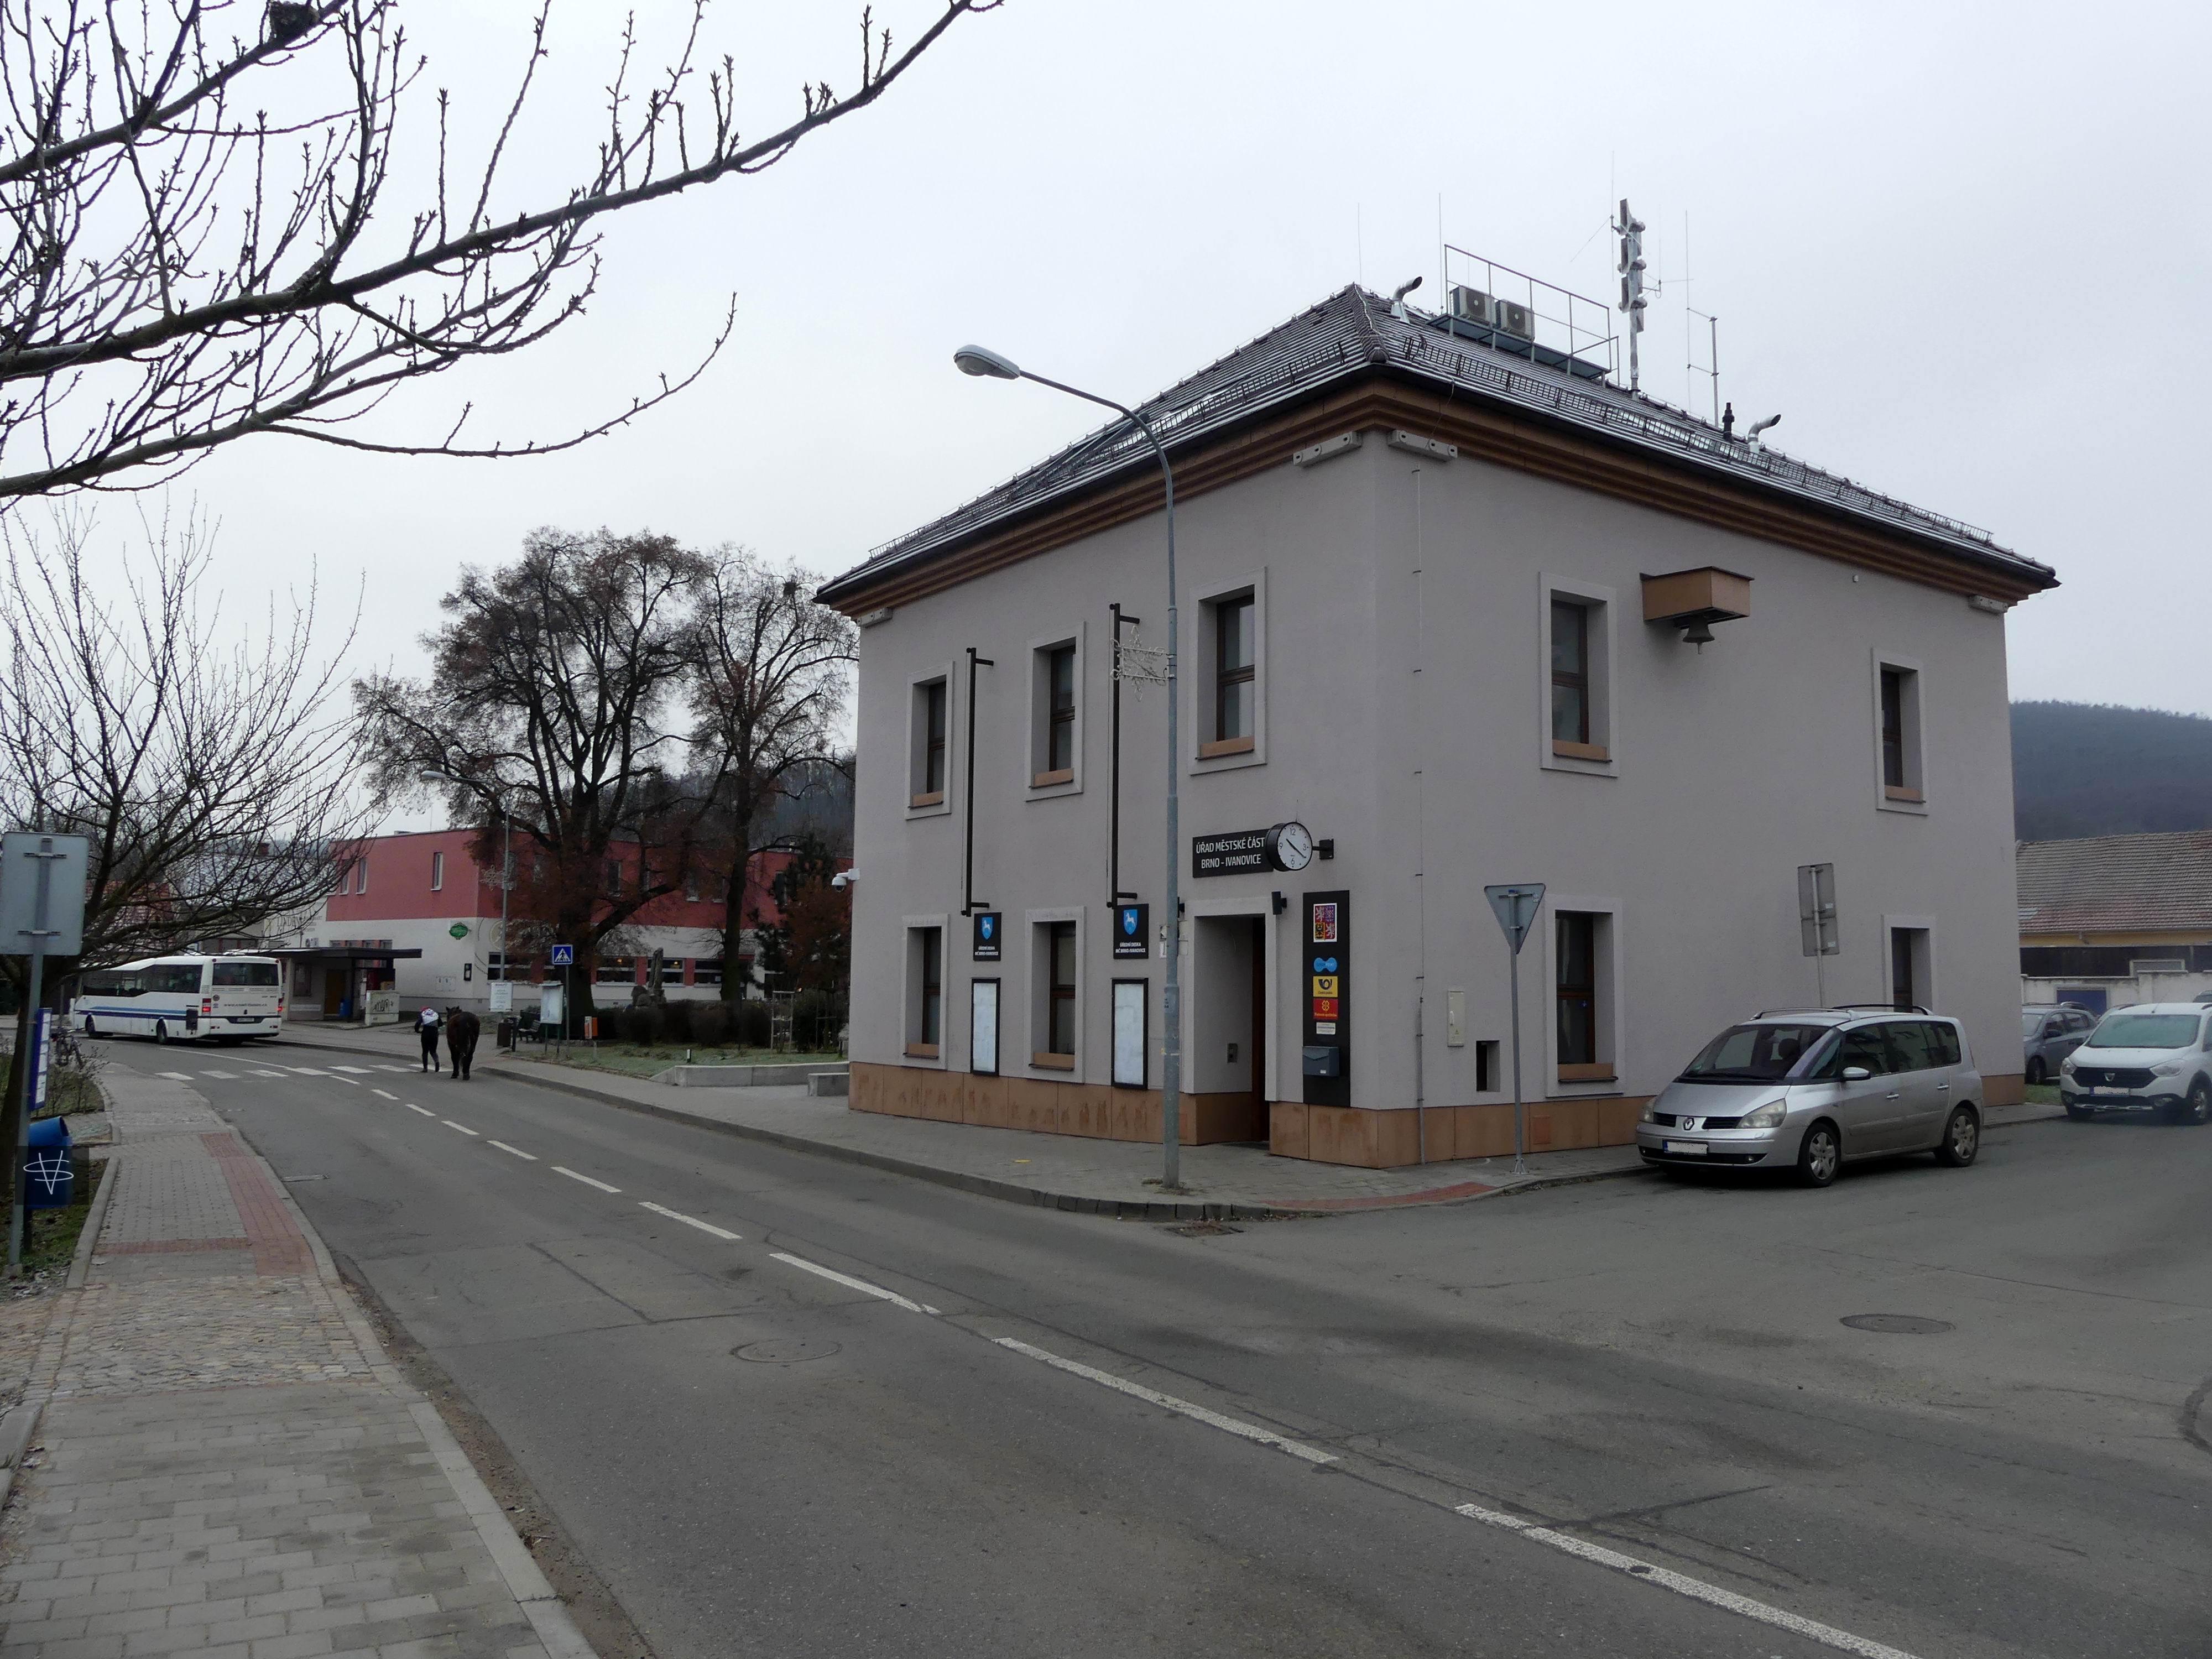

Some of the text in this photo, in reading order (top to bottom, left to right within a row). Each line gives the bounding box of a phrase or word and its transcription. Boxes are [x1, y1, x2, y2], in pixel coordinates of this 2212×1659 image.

[1196, 836, 1265, 854] ÚŘAD MĚSTSKÉ ČÁST
[1201, 858, 1220, 869] BRNO
[1225, 854, 1261, 867] IVANOVICE
